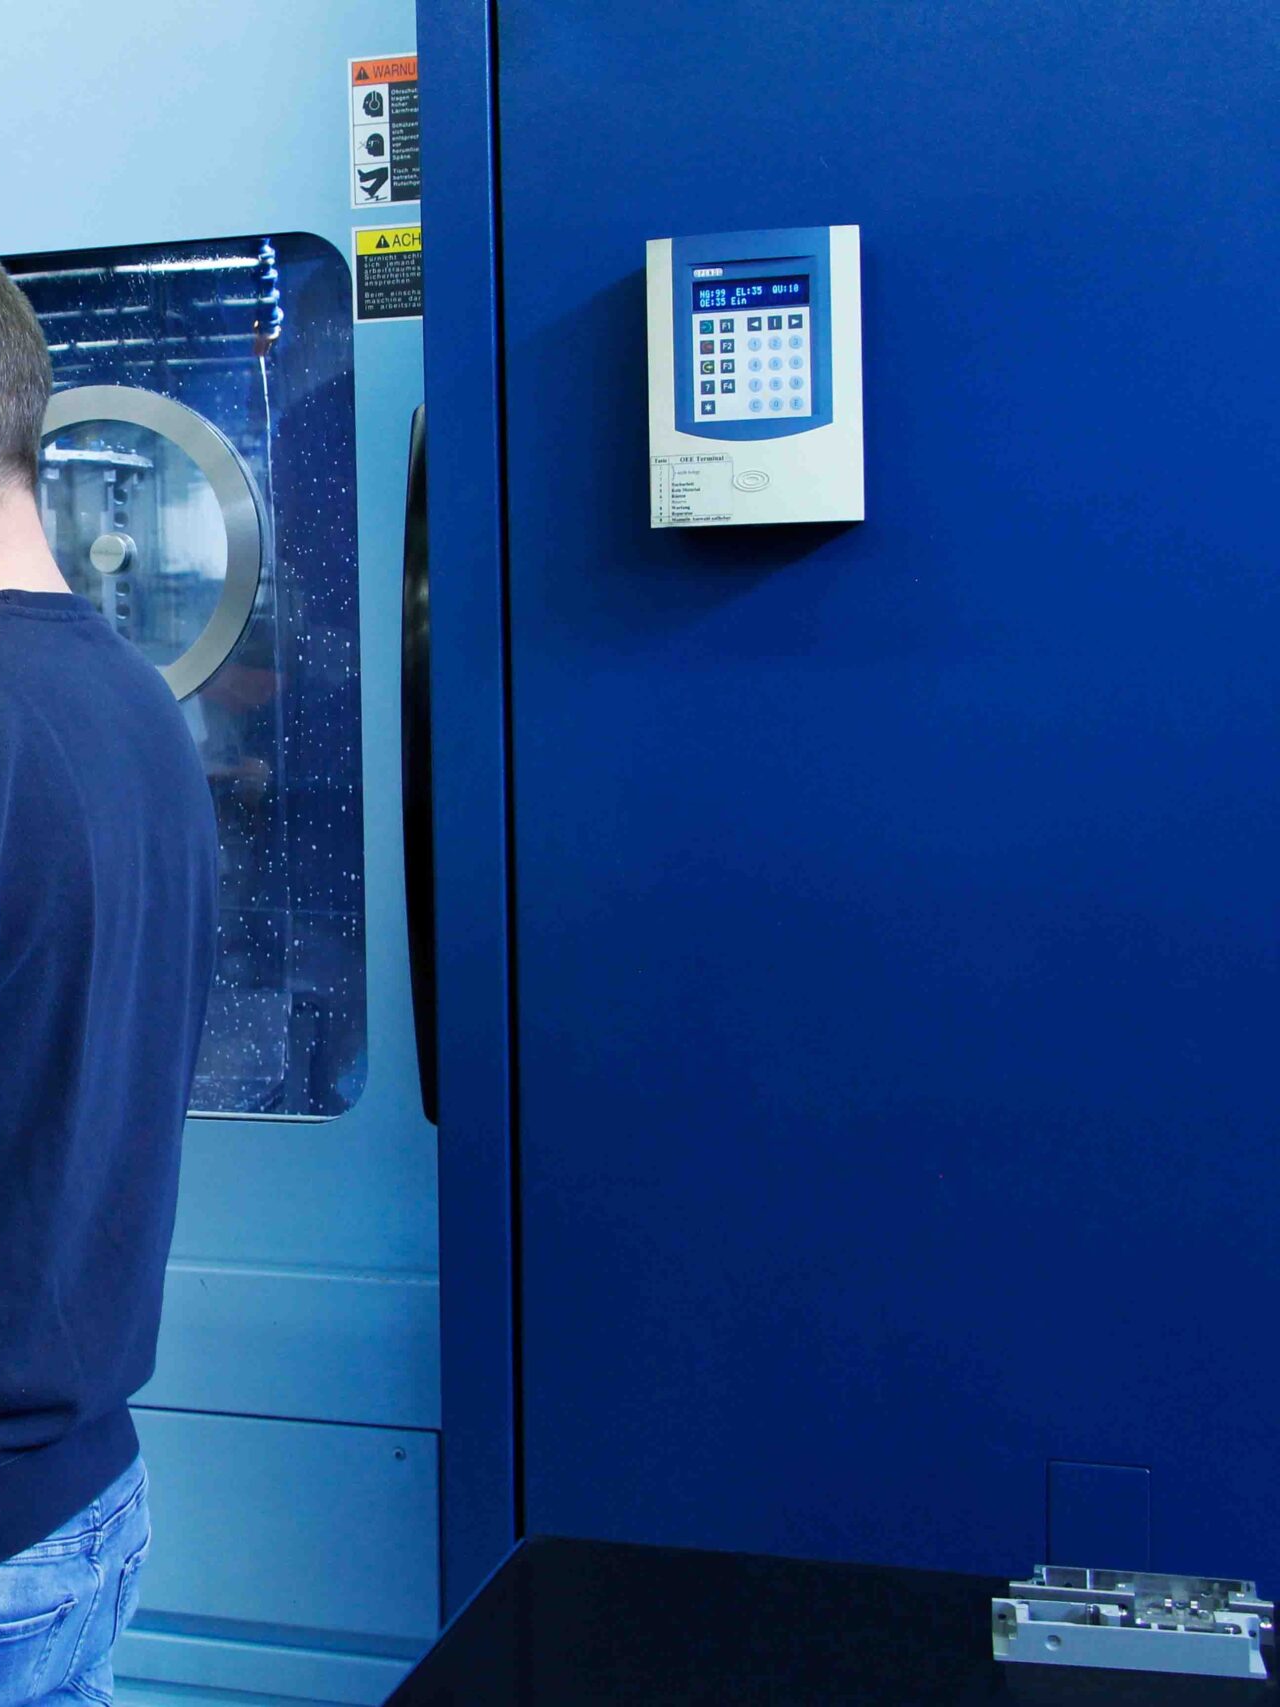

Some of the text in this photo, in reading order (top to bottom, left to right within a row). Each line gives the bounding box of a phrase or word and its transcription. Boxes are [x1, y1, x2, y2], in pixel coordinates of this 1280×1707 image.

[392, 233, 421, 247] ACH
[736, 286, 763, 297] EL:35
[700, 296, 747, 308] OE:35 Ein
[721, 322, 731, 330] F1
[722, 342, 732, 350] F2
[722, 362, 732, 370] F3
[723, 382, 733, 391] F4
